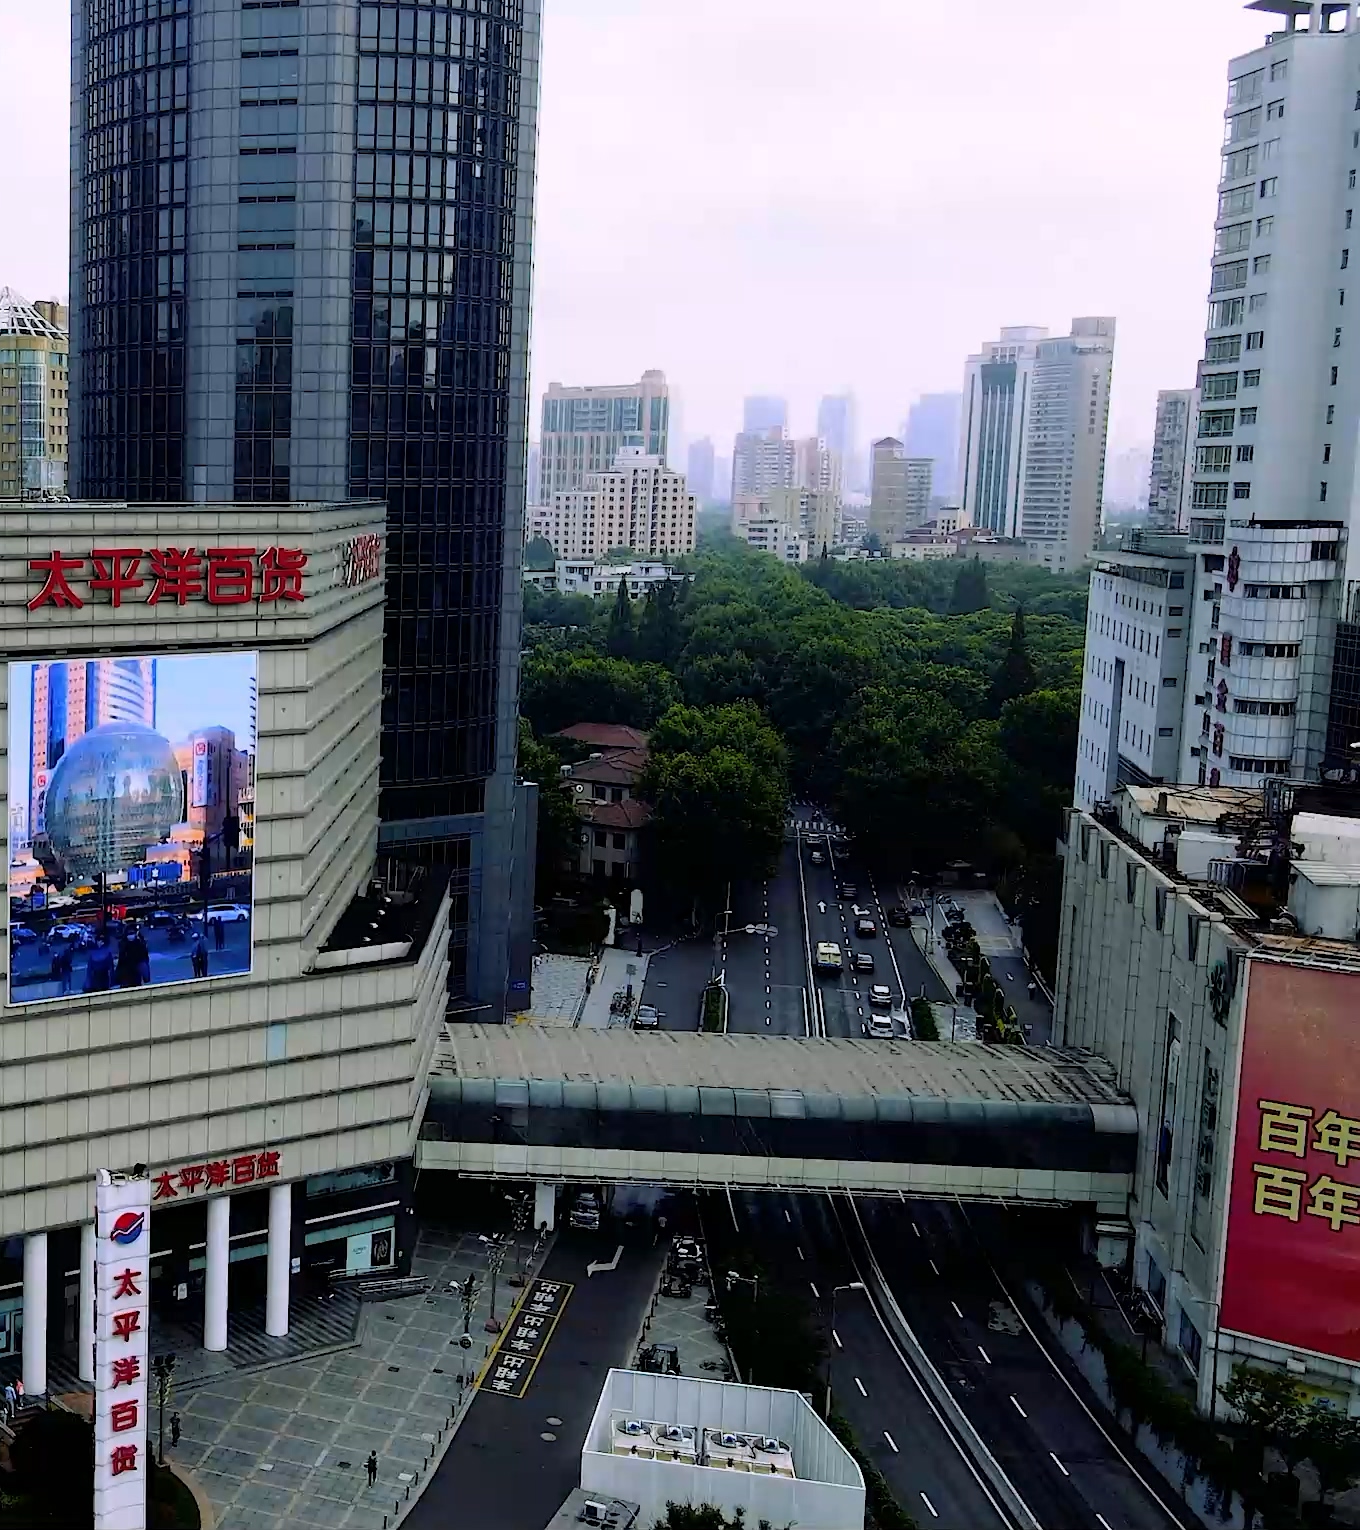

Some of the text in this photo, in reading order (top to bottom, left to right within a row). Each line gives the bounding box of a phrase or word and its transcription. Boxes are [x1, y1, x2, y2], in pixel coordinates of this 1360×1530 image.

[27, 547, 307, 611] 太平洋百货
[1258, 1099, 1360, 1166] 百年
[152, 1151, 280, 1201] 太平洋百货
[1253, 1163, 1360, 1231] 百年
[510, 1314, 545, 1351] 出租车
[111, 1268, 142, 1477] 太平洋百货
[491, 1354, 526, 1391] 出租车
